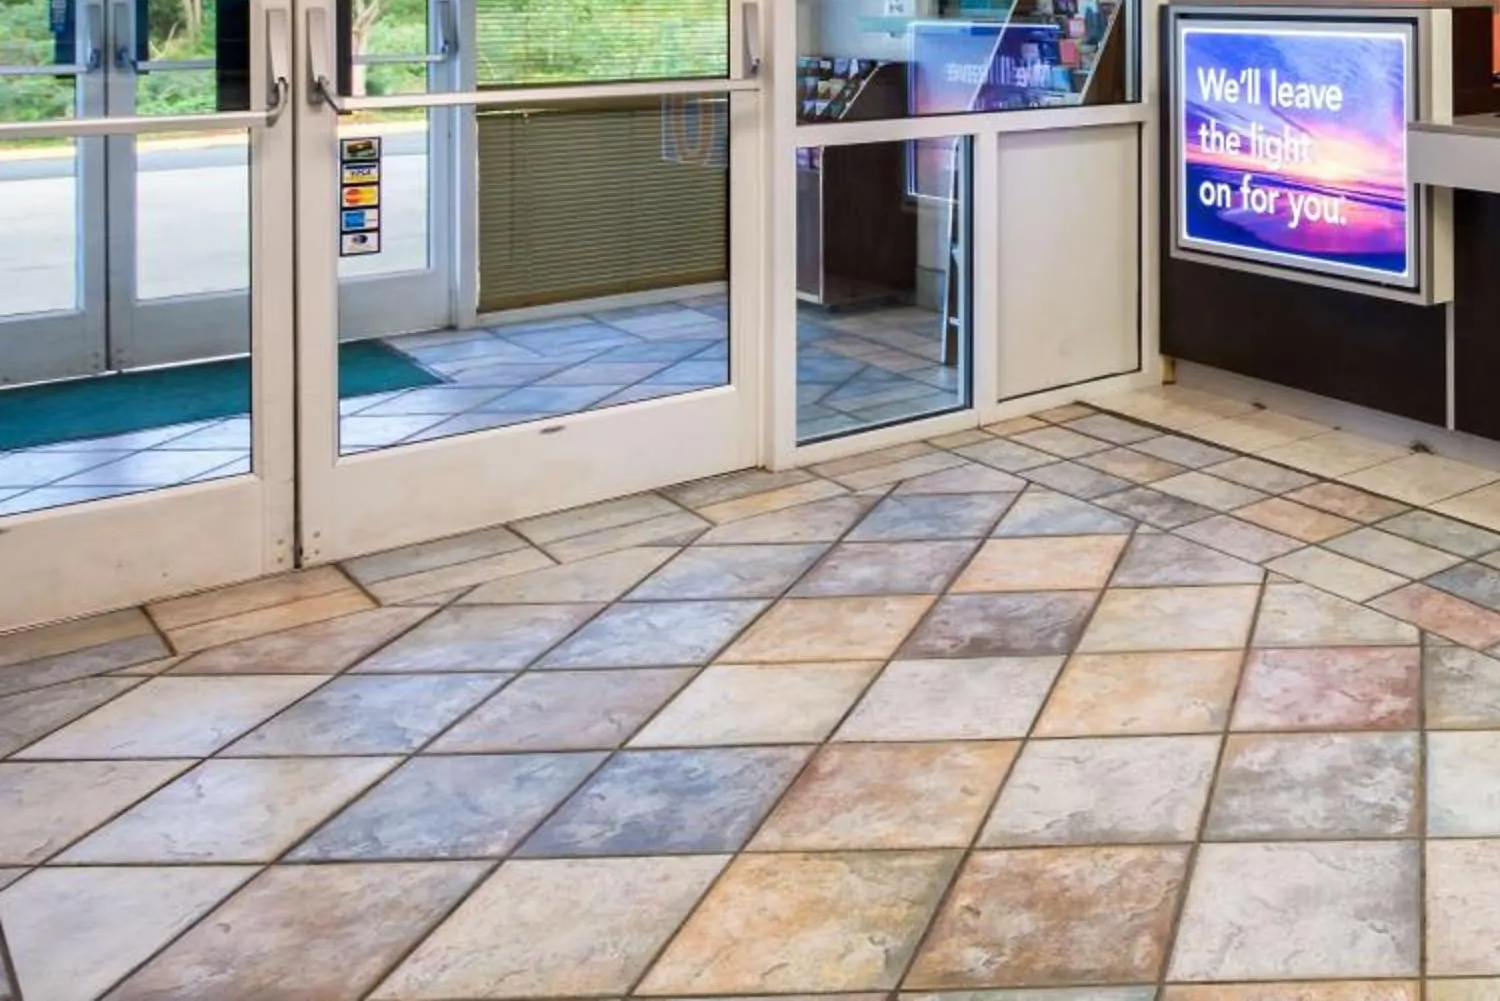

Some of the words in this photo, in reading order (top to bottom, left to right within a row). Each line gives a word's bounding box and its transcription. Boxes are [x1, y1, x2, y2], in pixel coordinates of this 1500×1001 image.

[1197, 67, 1261, 106] We'll
[1270, 68, 1344, 111] leave
[1198, 119, 1241, 155] the
[1250, 121, 1313, 170] light
[1199, 180, 1231, 209] on
[1240, 175, 1280, 214] for
[1288, 195, 1347, 229] you.
